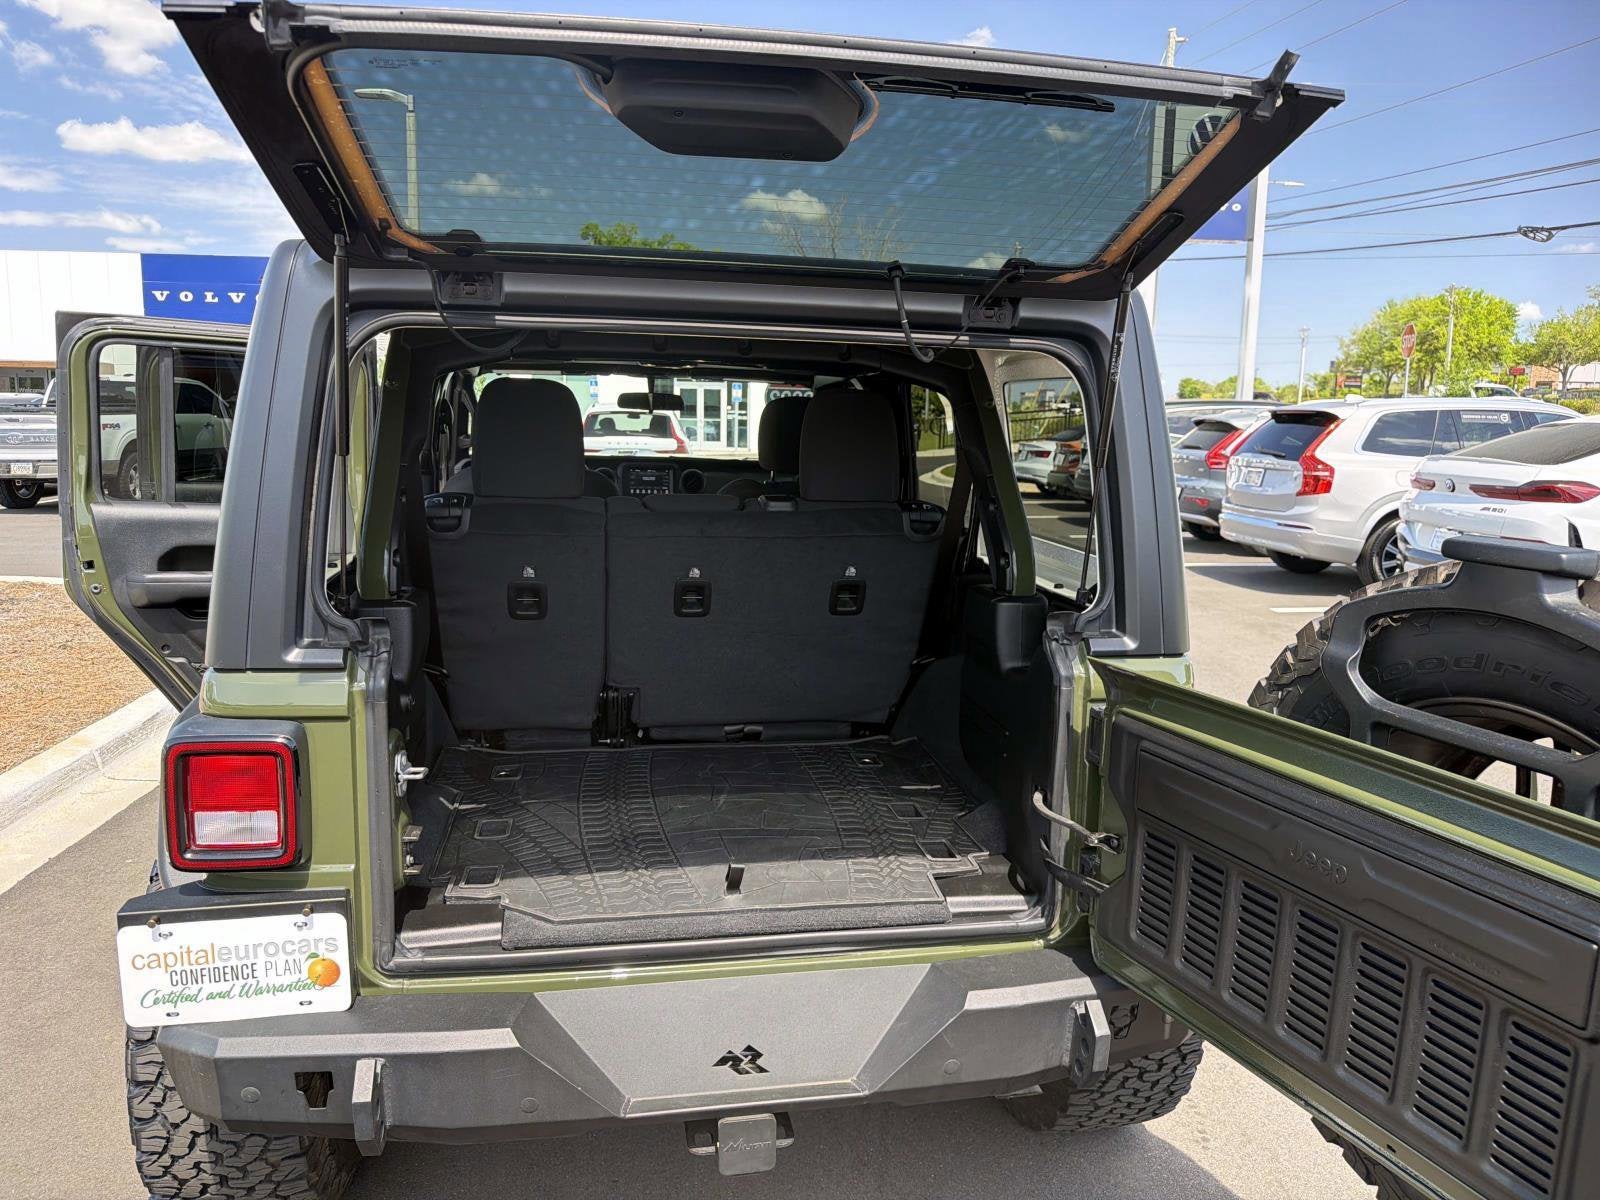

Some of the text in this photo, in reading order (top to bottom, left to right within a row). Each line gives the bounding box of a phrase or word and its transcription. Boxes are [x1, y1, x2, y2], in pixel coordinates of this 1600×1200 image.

[151, 290, 259, 303] VOLV
[1403, 334, 1415, 349] STOP
[1287, 840, 1348, 885] Jeep
[131, 935, 339, 973] capitaleurocars
[169, 957, 303, 988] CONFIDENCE PLAN
[140, 973, 328, 1009] Certified and Warrantied
